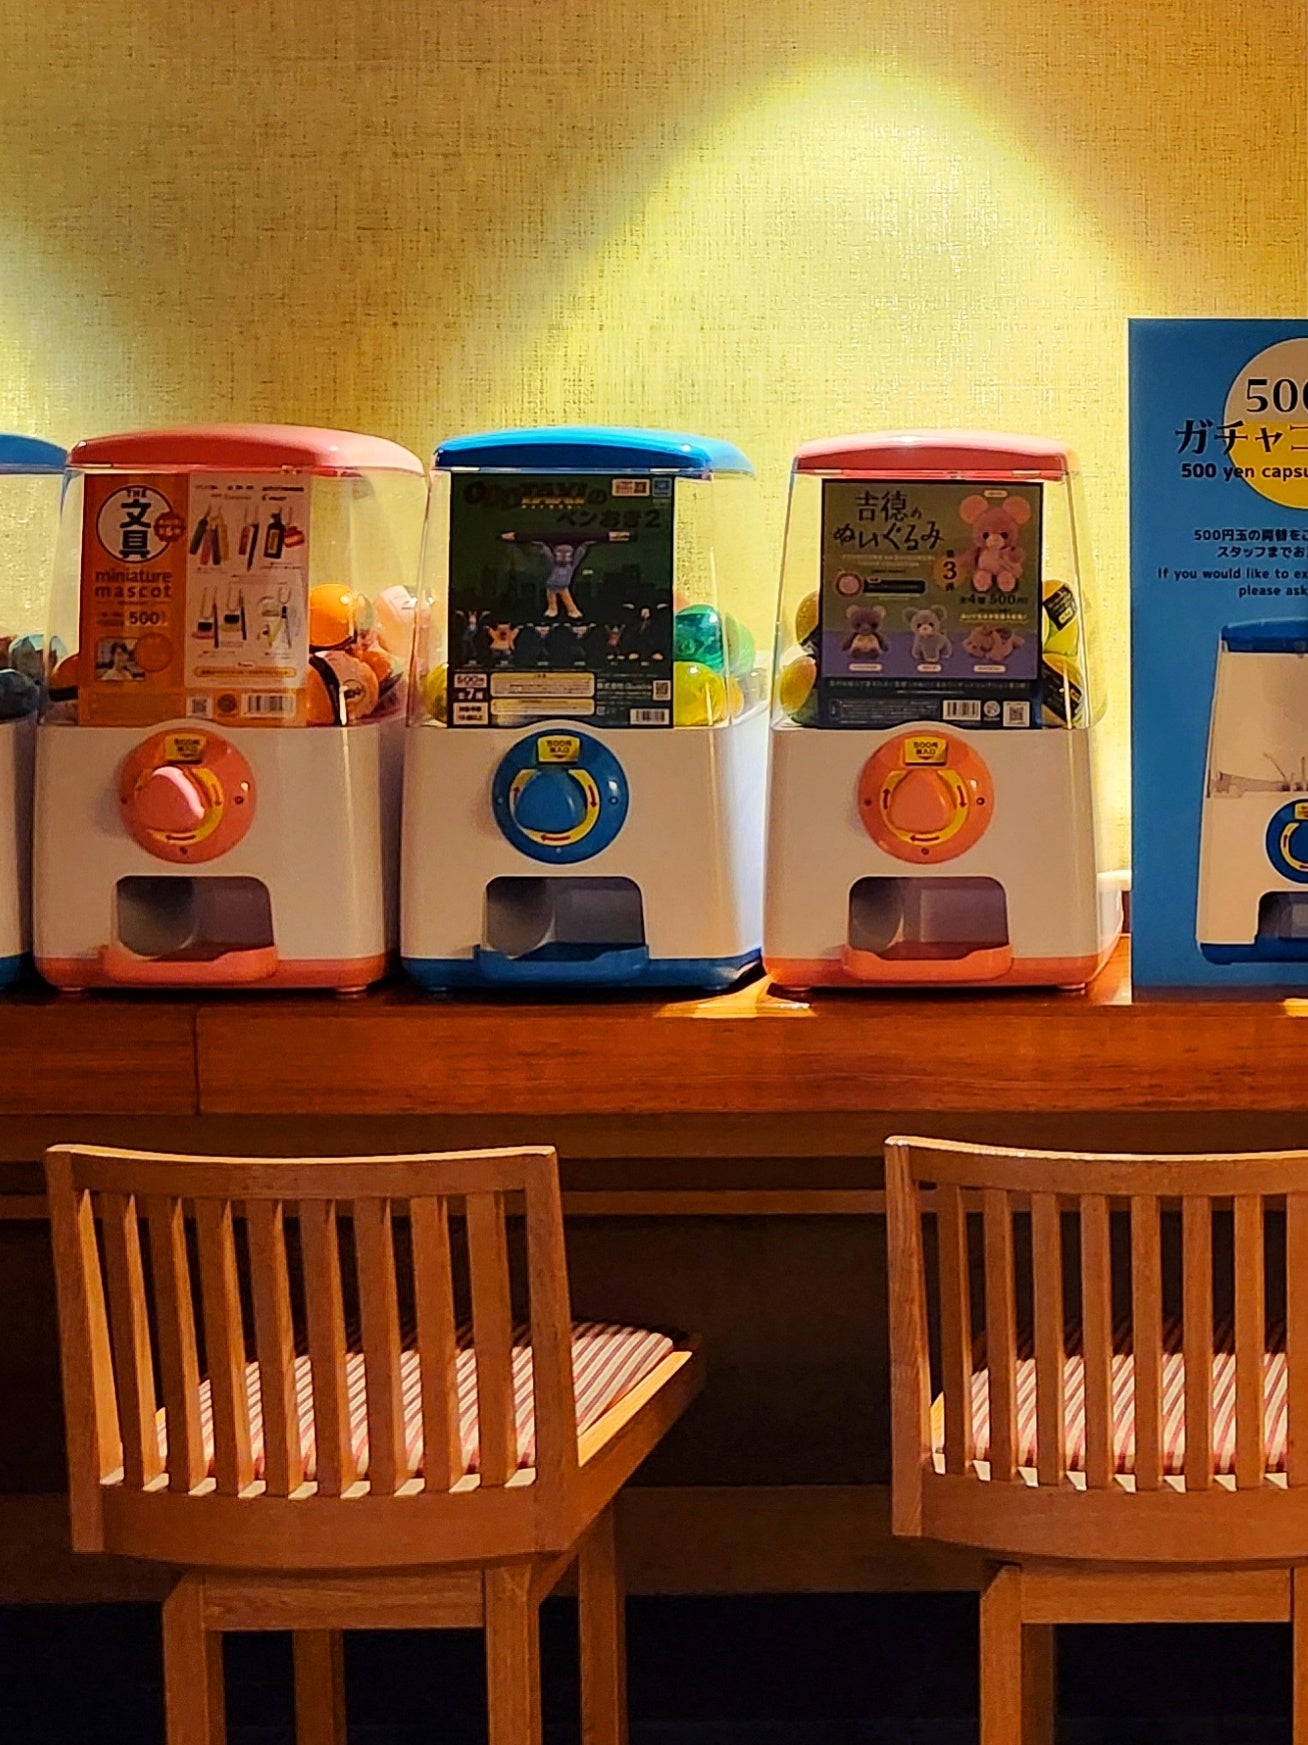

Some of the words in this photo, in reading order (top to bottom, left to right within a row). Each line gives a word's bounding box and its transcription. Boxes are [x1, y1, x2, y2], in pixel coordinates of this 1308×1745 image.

[1181, 463, 1216, 479] 500
[1223, 466, 1255, 482] yen
[126, 489, 147, 498] THE
[119, 498, 151, 558] 文具
[833, 521, 945, 551] ぬいぐるみ
[95, 568, 173, 582] miniature
[1158, 568, 1170, 579] If
[1175, 570, 1197, 582] you
[1202, 568, 1241, 579] would
[1246, 568, 1269, 579] like
[1275, 569, 1289, 579] to
[94, 584, 172, 598] mascot
[1238, 584, 1281, 597] please
[1285, 584, 1308, 596] ask
